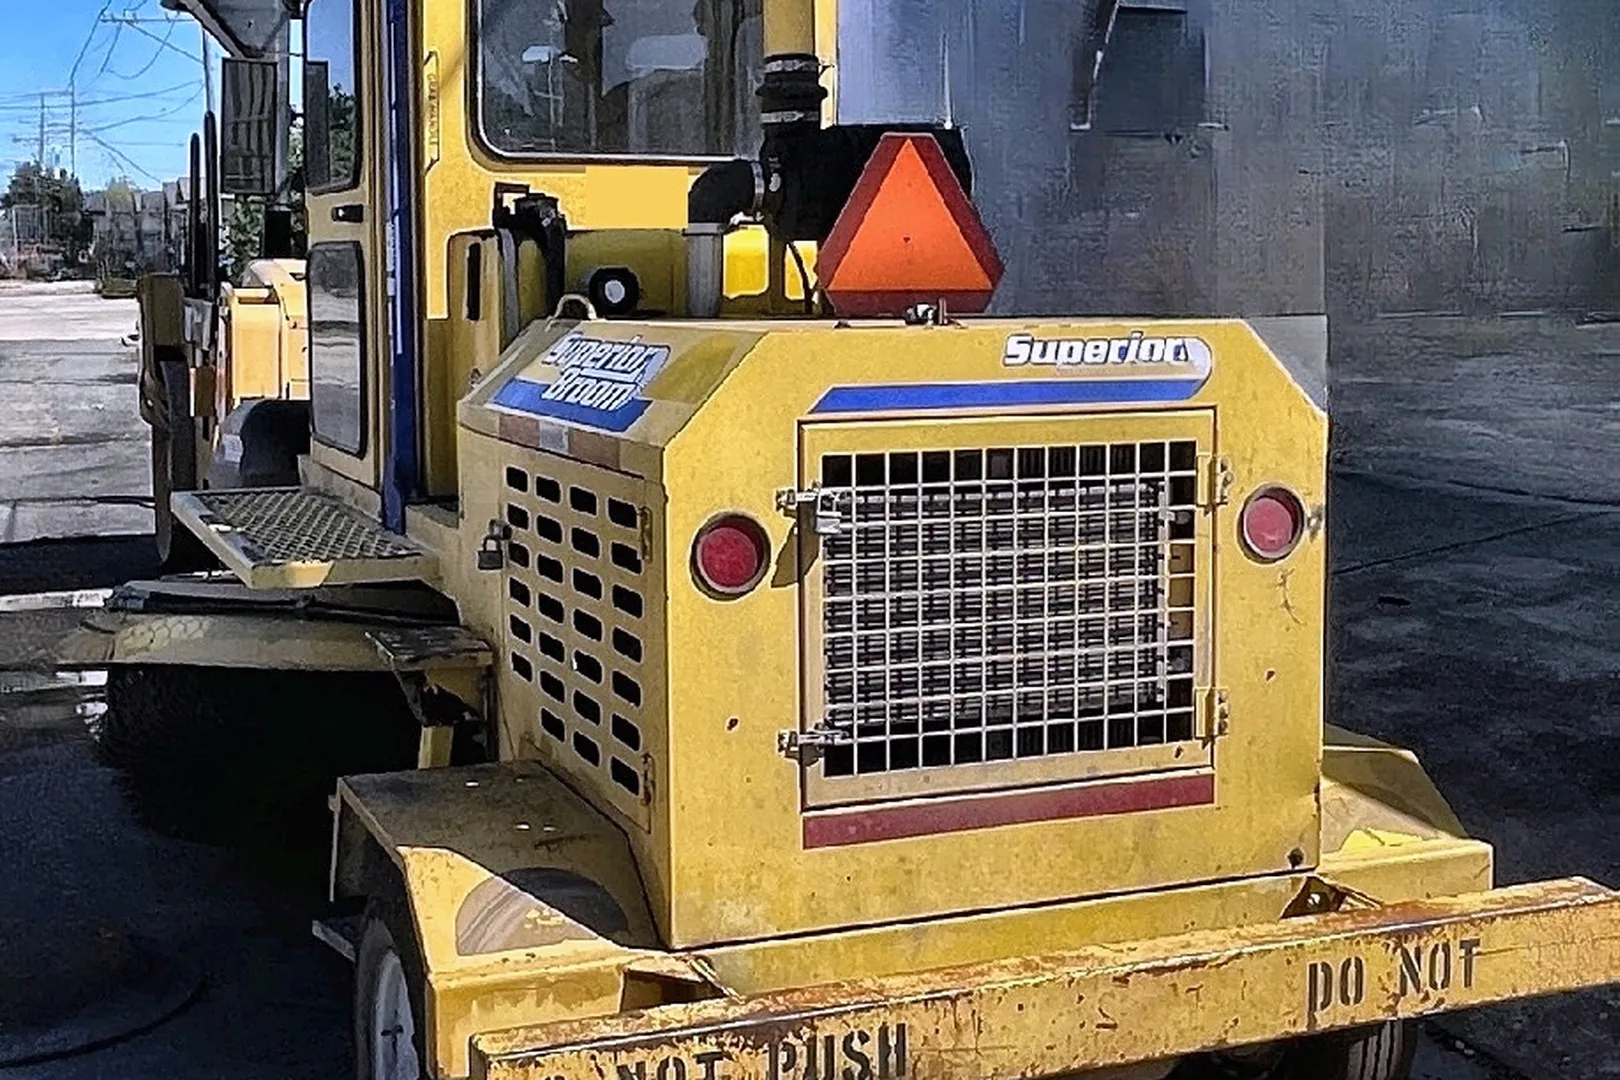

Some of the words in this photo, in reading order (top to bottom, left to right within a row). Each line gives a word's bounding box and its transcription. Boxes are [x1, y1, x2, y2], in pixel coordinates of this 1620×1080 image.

[1003, 330, 1191, 366] Superior
[541, 367, 638, 411] Broom
[1306, 955, 1365, 1013] DO
[1399, 938, 1481, 997] NOT
[768, 1022, 907, 1080] PUSH
